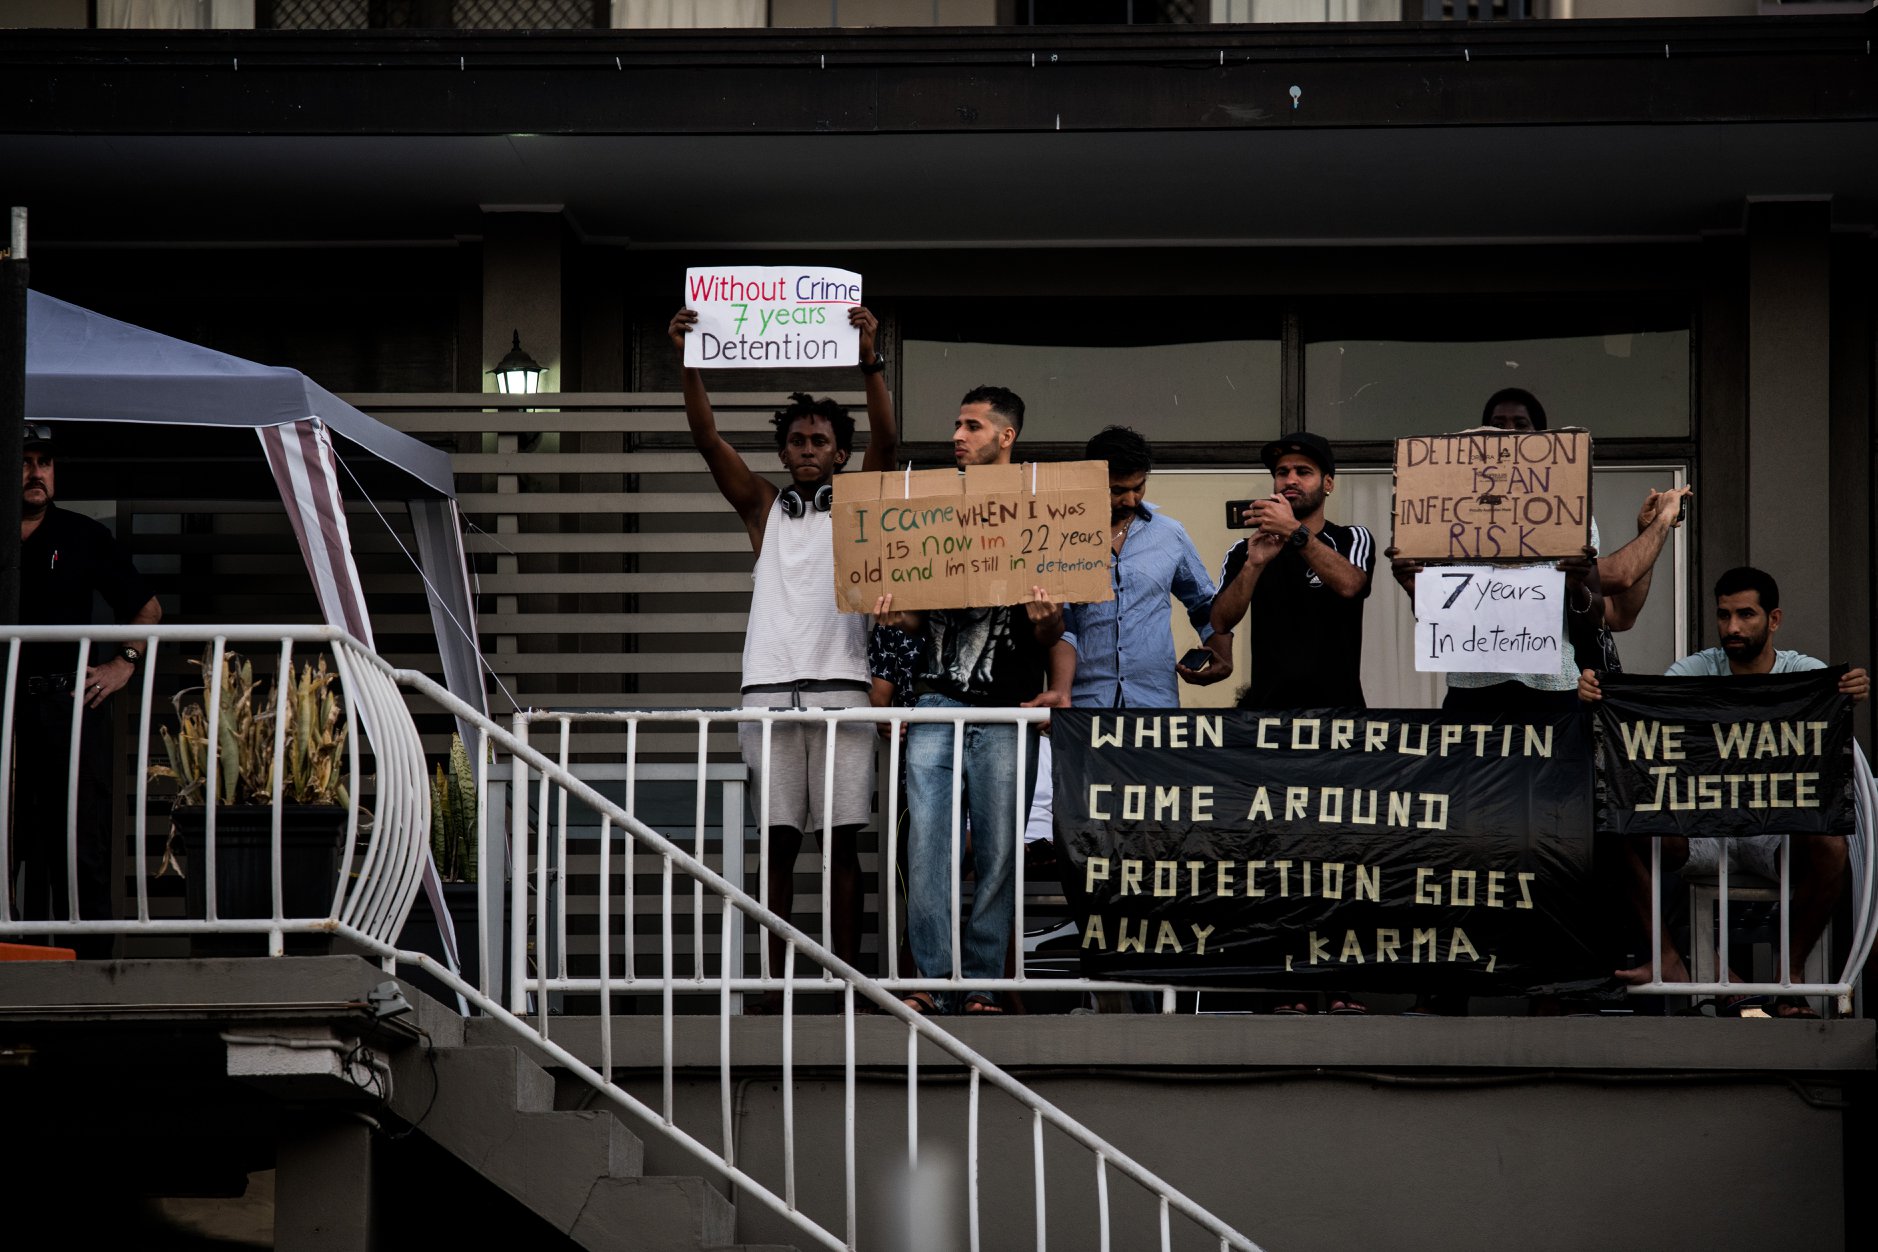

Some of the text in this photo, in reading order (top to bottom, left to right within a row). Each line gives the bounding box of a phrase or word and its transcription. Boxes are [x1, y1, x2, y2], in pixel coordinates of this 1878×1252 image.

[690, 275, 860, 302] Without Crime
[730, 303, 826, 337] 7 years
[702, 332, 838, 361] Detention
[1407, 433, 1578, 467] DETENTION
[1472, 466, 1499, 495] IS
[1507, 466, 1552, 495] AN
[854, 509, 868, 543] I
[881, 505, 954, 532] came
[1027, 501, 1038, 519] I
[1400, 495, 1585, 526] INFECTION
[886, 540, 910, 560] 15
[922, 533, 973, 557] now
[1020, 524, 1050, 555] 22
[1059, 528, 1104, 552] years
[1448, 522, 1542, 558] RISK
[850, 559, 882, 584] old
[891, 557, 934, 582] and
[971, 556, 999, 573] still
[1009, 554, 1026, 572] in
[1441, 573, 1546, 611] 7 years
[1429, 622, 1557, 659] In detention
[1091, 715, 1553, 758] WHEN CORRUPTIN
[1620, 720, 1828, 760] WE WANT
[1089, 784, 1449, 830] COME AROUND
[1634, 766, 1820, 812] JUSTICE
[1085, 857, 1536, 910] PROTECTION GOES
